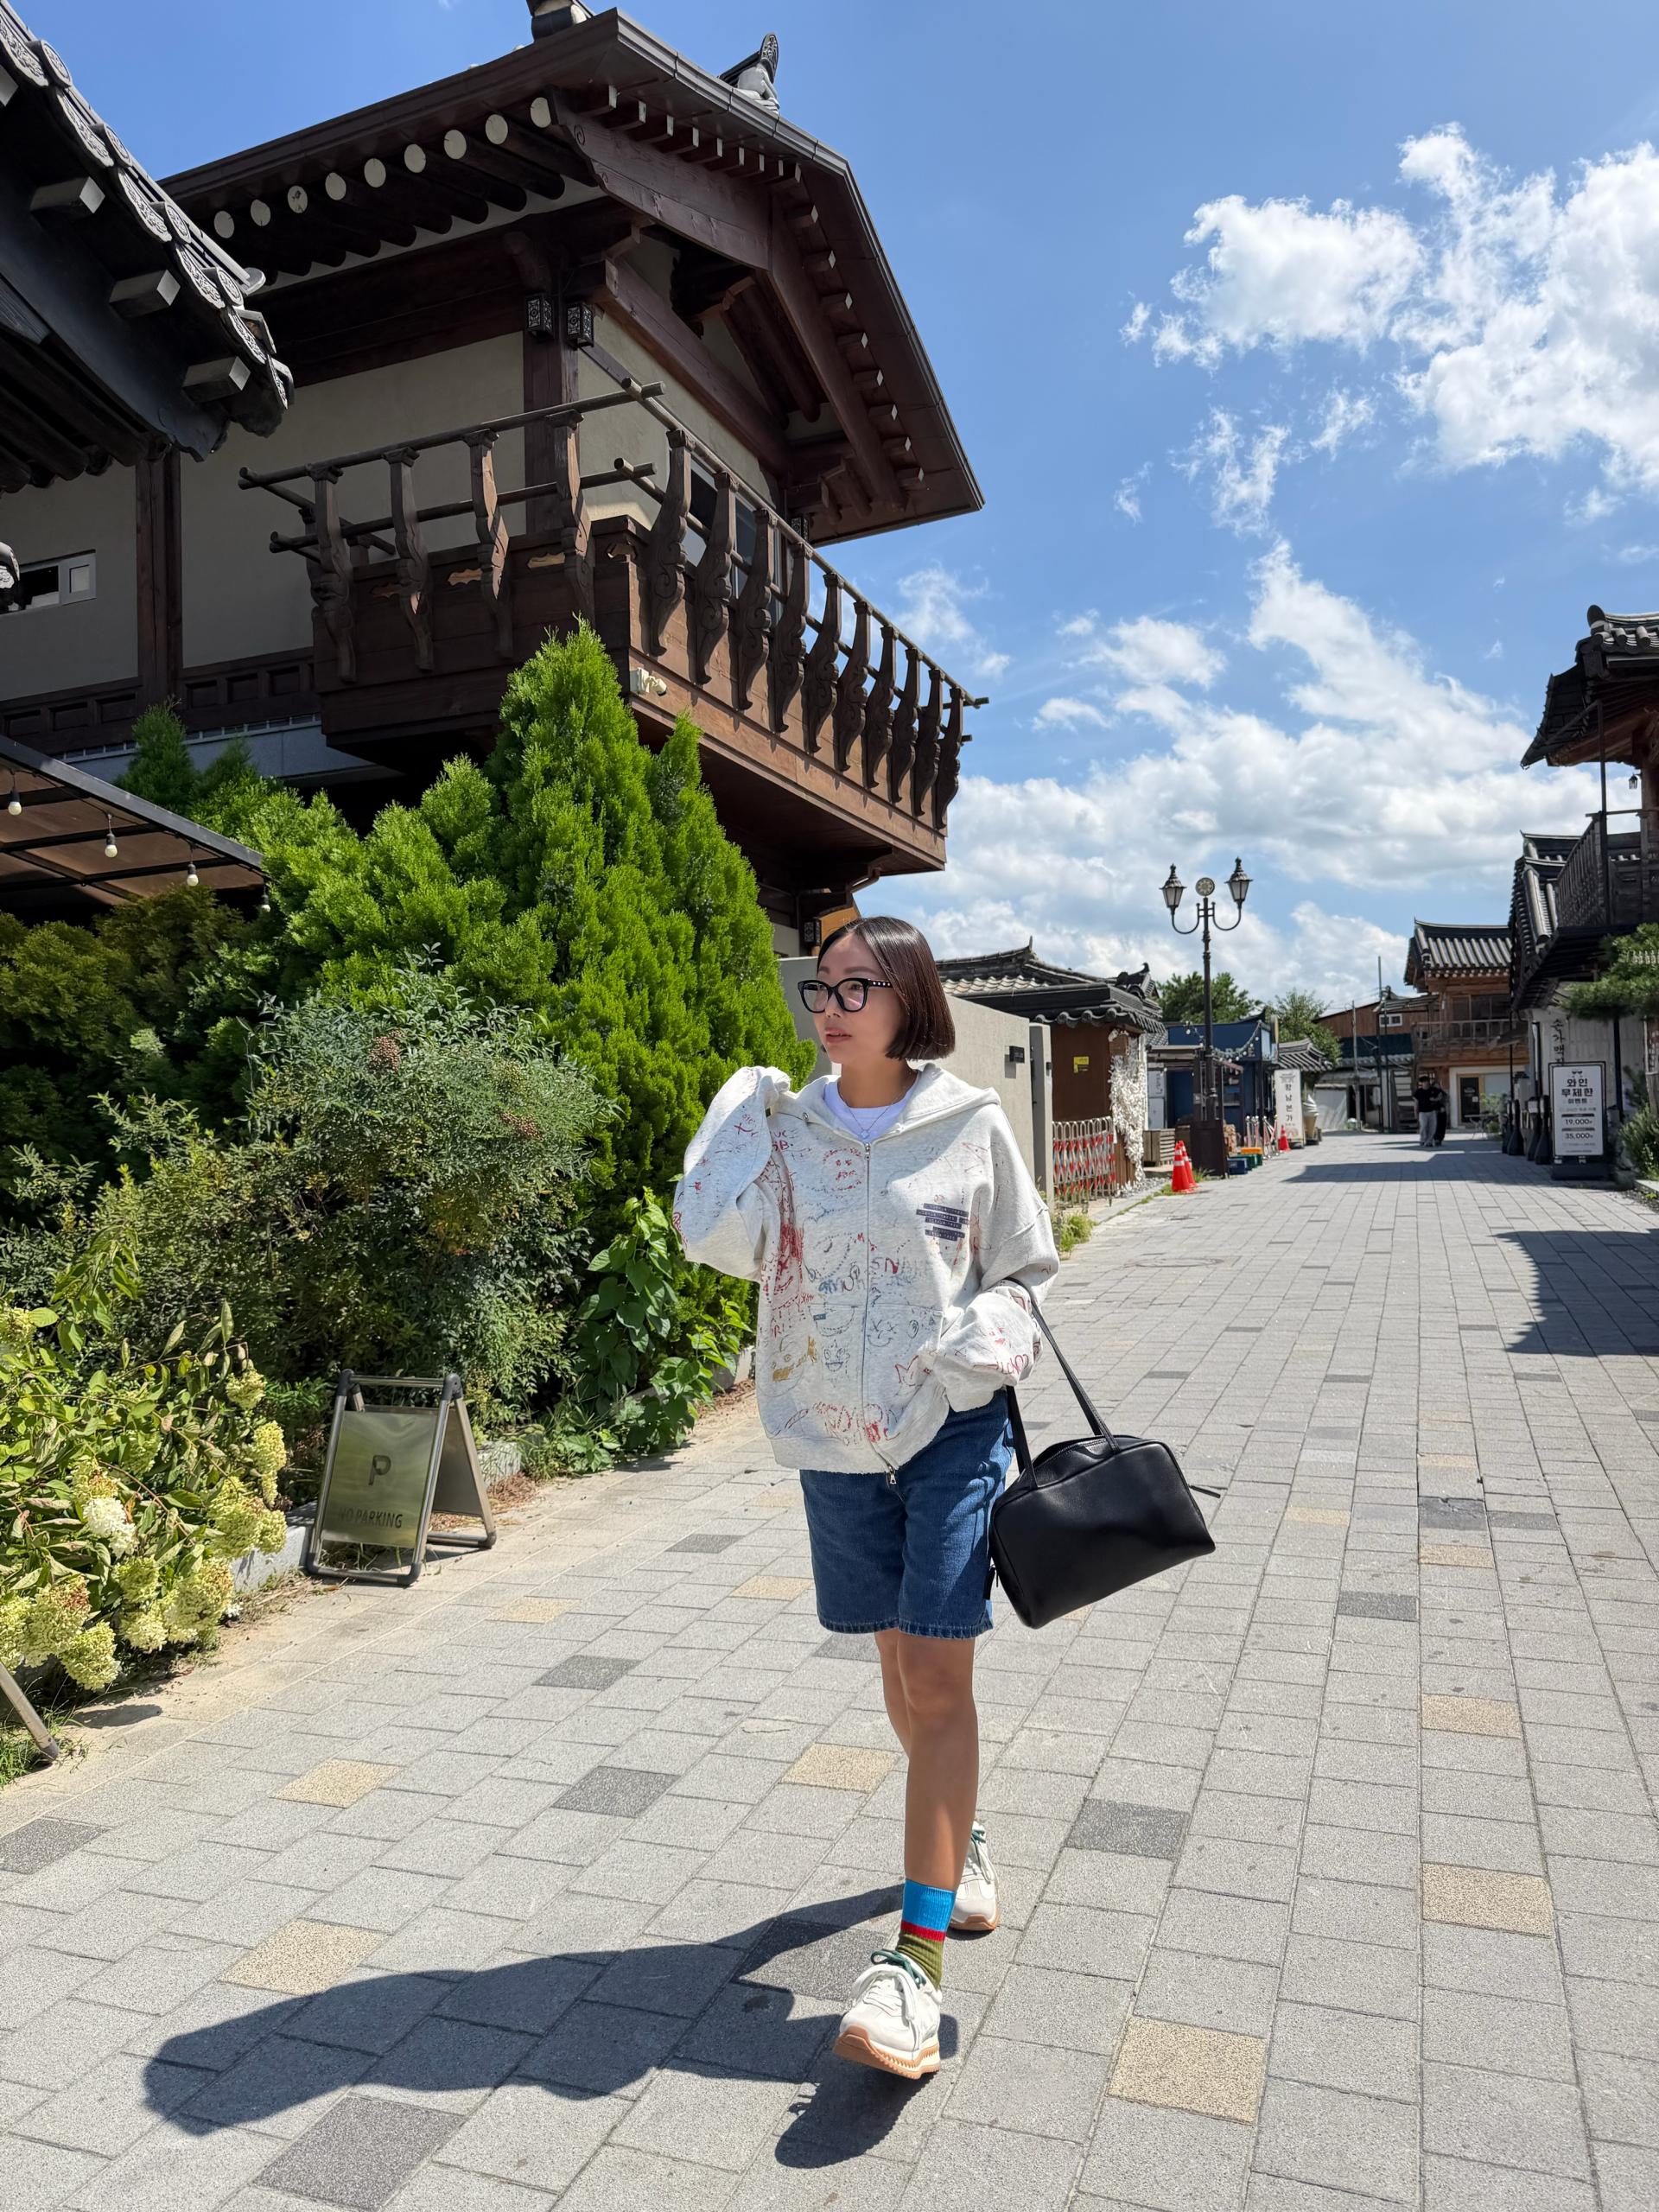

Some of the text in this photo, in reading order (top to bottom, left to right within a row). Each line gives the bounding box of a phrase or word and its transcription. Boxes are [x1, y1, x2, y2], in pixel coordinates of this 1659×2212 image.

[1567, 1078, 1588, 1087] 와인
[1561, 1088, 1593, 1097] 무제한
[368, 1455, 391, 1485] P
[354, 1508, 403, 1529] PARKING
